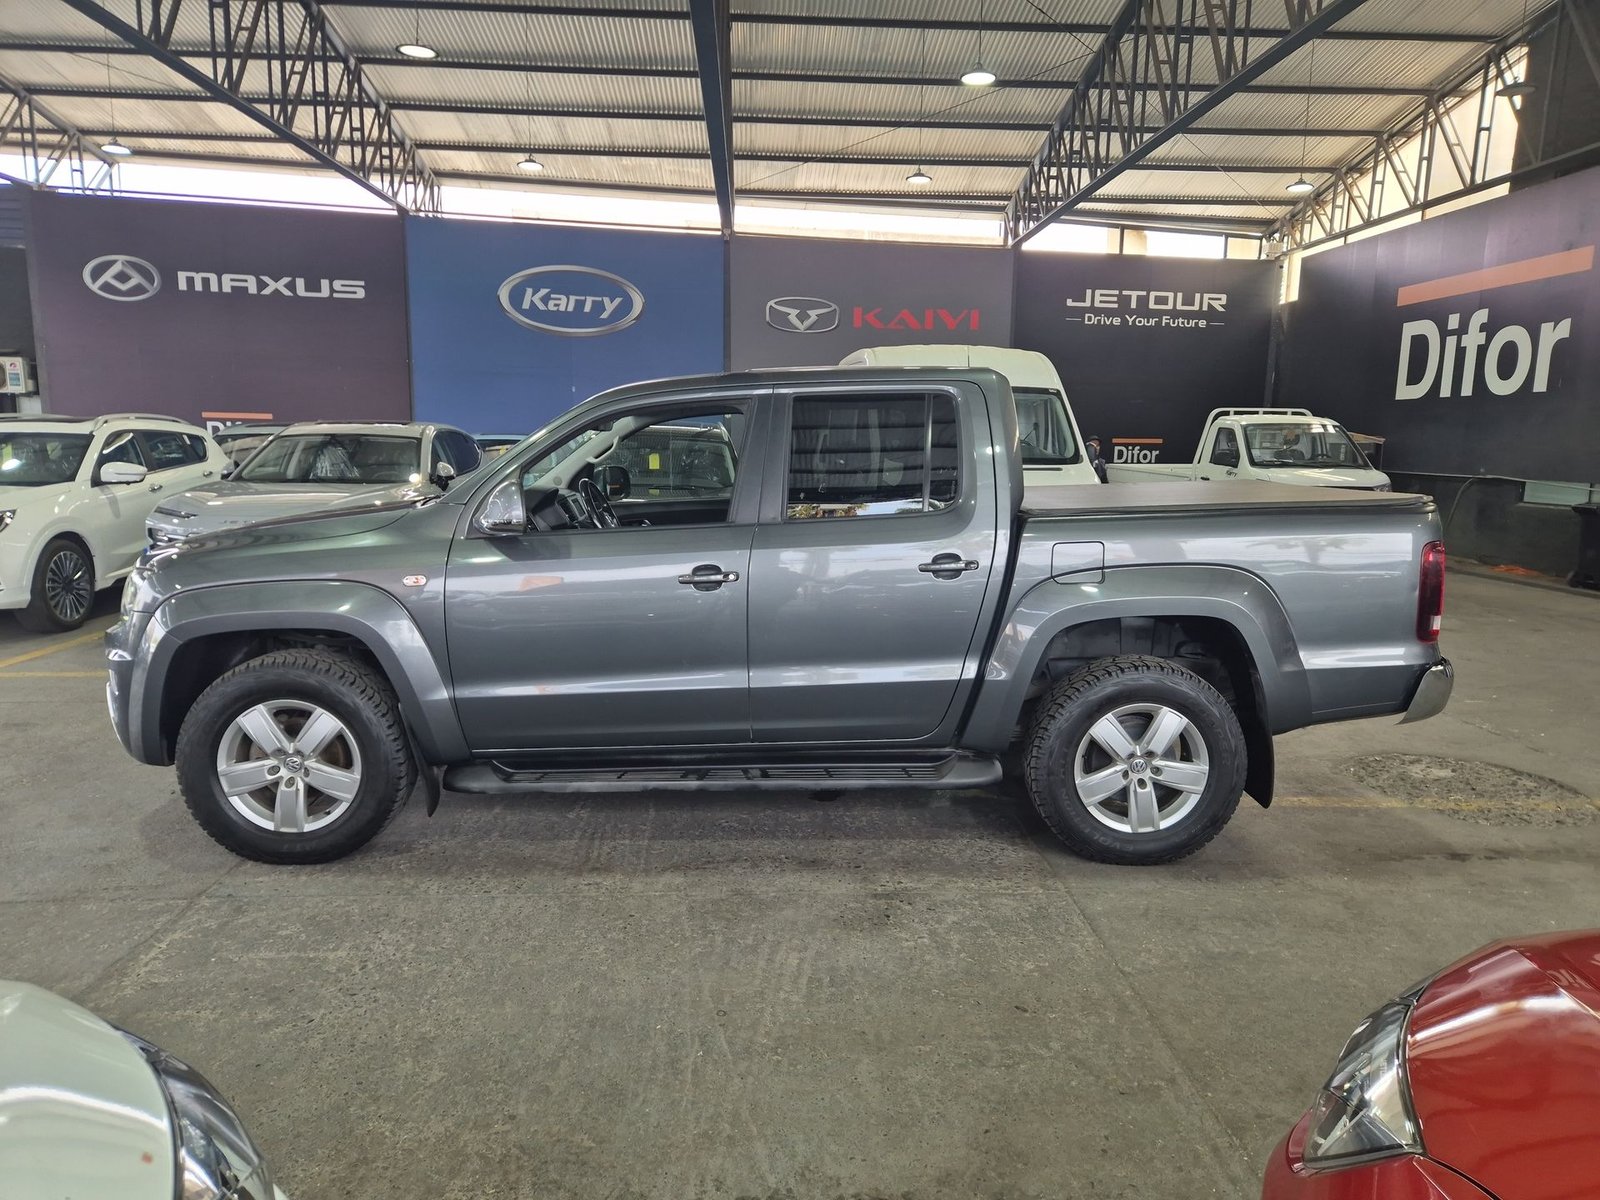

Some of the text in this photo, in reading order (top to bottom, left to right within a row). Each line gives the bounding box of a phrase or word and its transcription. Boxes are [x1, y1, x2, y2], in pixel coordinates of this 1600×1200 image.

[177, 270, 366, 299] MAXUS
[521, 287, 624, 319] Karry
[1066, 288, 1228, 312] JETOUR
[1084, 313, 1207, 328] Drive Your Future
[1395, 308, 1572, 401] Difor
[1113, 445, 1160, 464] Difor
